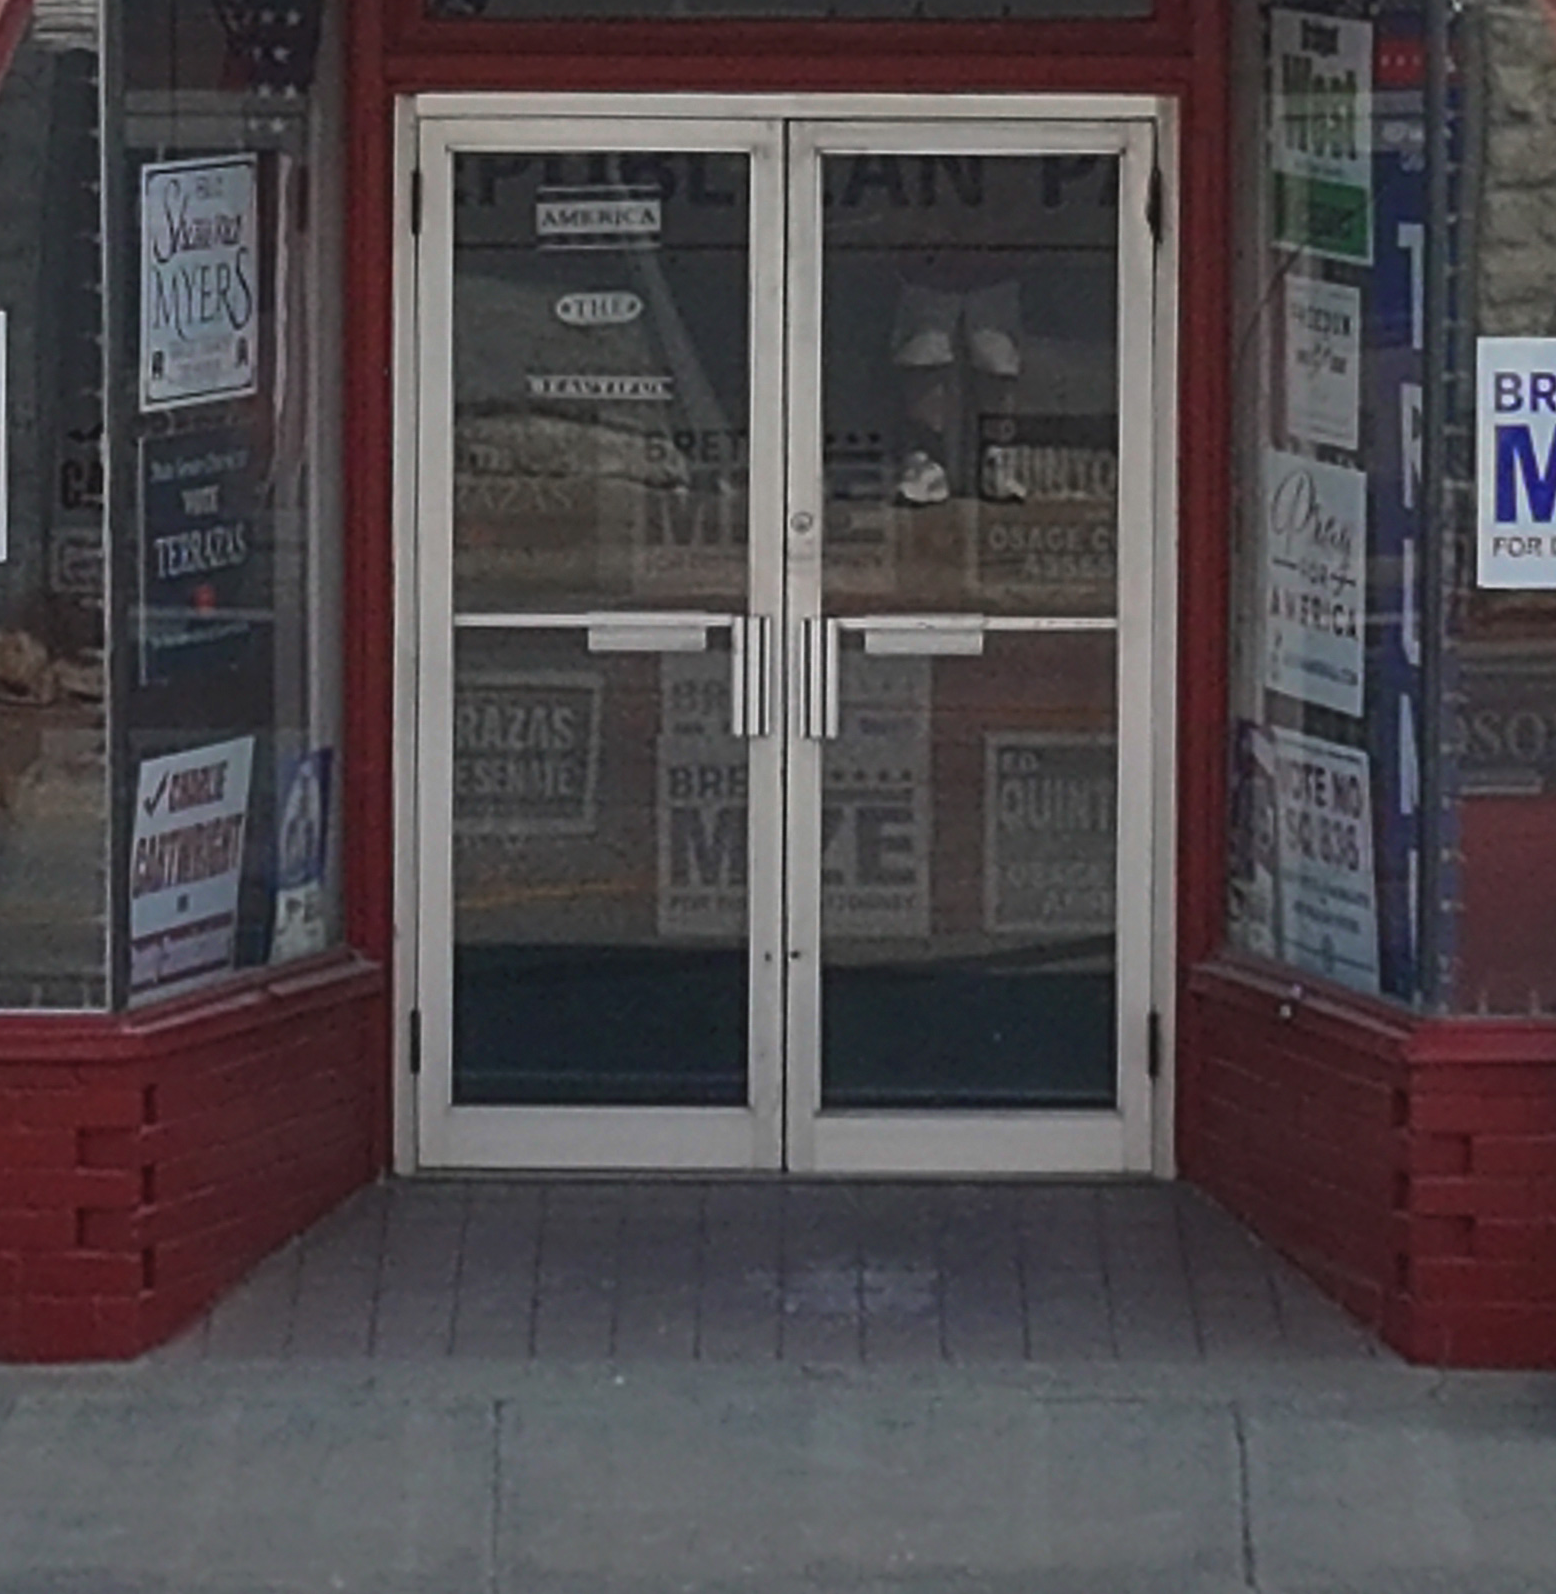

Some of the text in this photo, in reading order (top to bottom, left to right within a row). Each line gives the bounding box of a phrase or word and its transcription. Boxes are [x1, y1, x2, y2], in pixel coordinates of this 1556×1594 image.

[542, 208, 656, 227] AMERICA
[151, 246, 253, 342] MYERS
[1494, 536, 1543, 557] FOR
